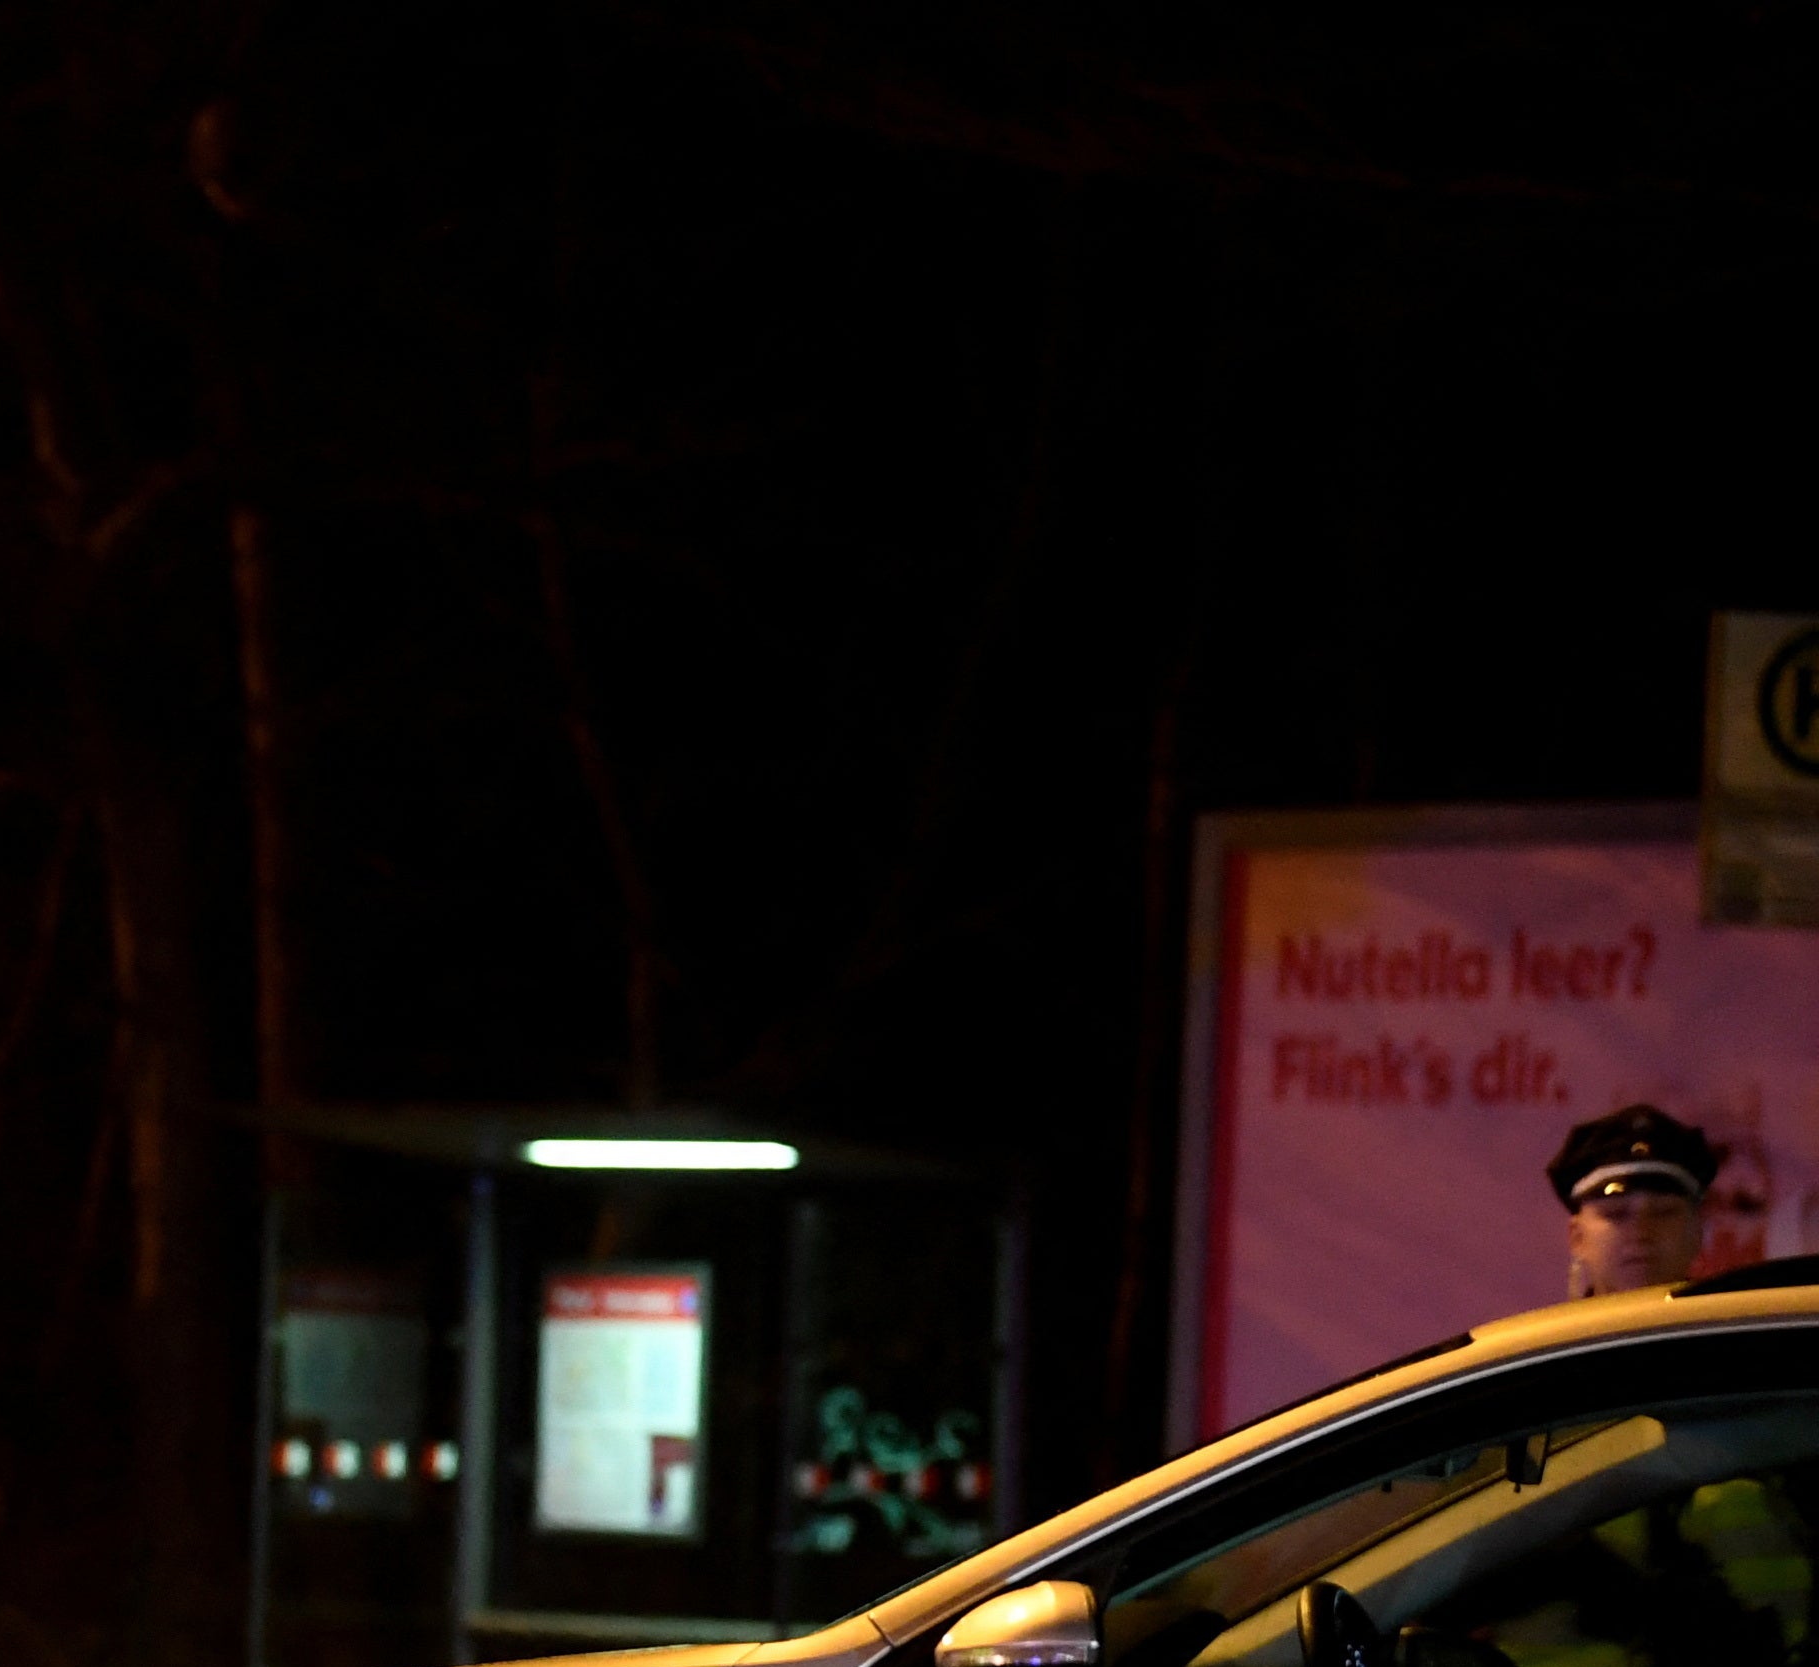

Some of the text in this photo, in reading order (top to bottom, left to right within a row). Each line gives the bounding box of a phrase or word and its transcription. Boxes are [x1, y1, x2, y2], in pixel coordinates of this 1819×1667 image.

[1275, 924, 1657, 998] Nutella leer?
[1272, 1030, 1570, 1105] Flink's dir.
